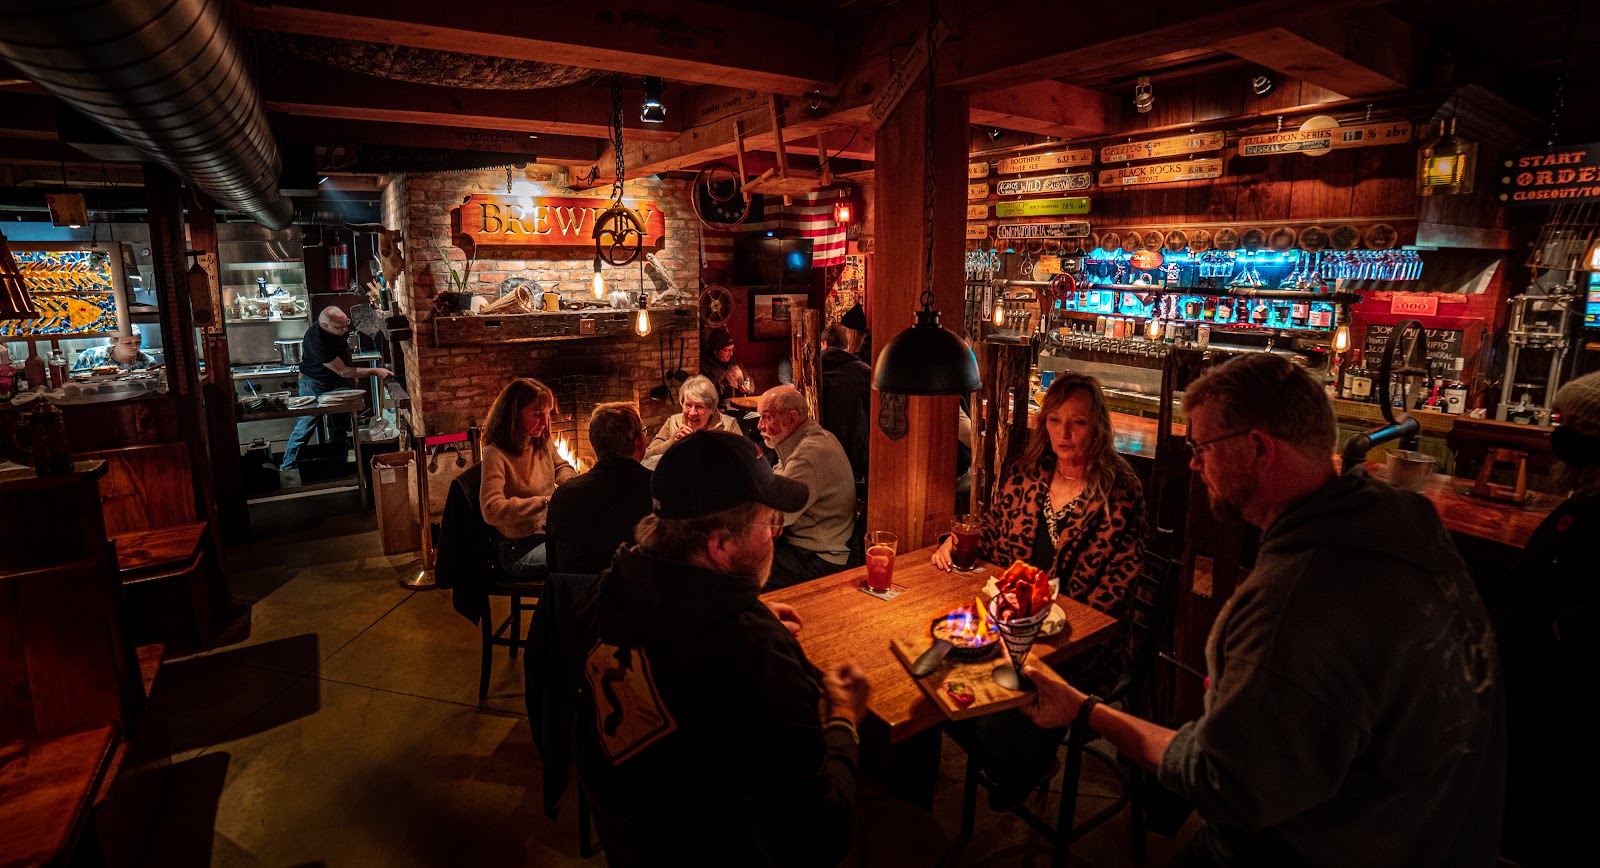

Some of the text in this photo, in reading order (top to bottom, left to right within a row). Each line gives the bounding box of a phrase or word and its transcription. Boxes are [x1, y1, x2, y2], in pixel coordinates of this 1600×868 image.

[745, 89, 758, 101] Club
[1244, 129, 1332, 146] FULL MOON SERIES
[1385, 124, 1409, 138] abv
[1104, 143, 1143, 157] CRYPTOS
[1010, 155, 1041, 165] BOOTHBAY
[1519, 151, 1587, 167] START
[1027, 163, 1039, 171] ALE
[1118, 163, 1183, 178] BLACK ROCKS
[1138, 175, 1159, 184] STOUT
[1516, 166, 1600, 186] ORDE
[1020, 179, 1042, 192] WILD
[1045, 178, 1069, 191] SAISON
